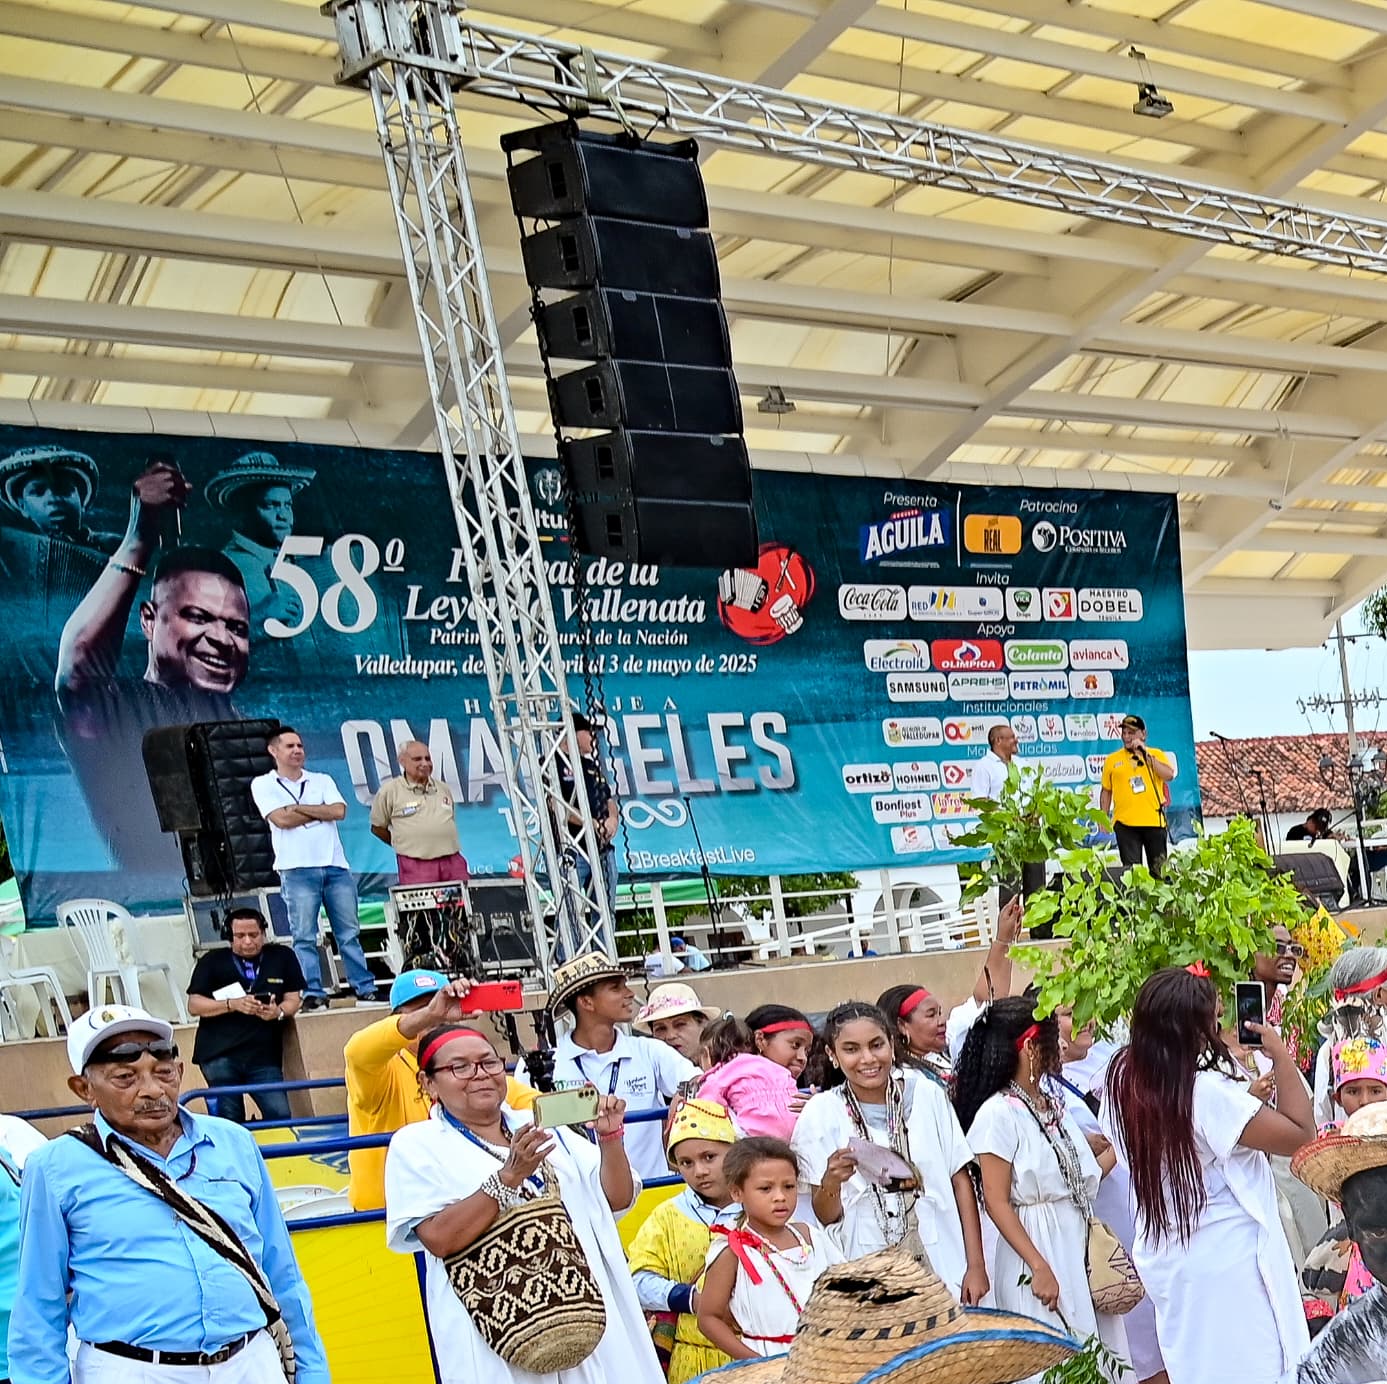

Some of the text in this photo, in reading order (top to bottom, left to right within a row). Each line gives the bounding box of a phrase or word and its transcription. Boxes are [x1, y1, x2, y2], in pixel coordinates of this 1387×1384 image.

[883, 491, 938, 508] Presenta
[1019, 499, 1078, 514] Patrocina
[864, 512, 945, 561] AGUILA
[983, 529, 1002, 553] REAL
[1059, 526, 1128, 549] POSITIVA
[586, 557, 624, 586] de
[976, 571, 1010, 586] Invita
[561, 586, 706, 623] Vallenata
[1081, 600, 1138, 613] DOBEL
[595, 629, 613, 646] de
[618, 629, 632, 646] la
[636, 628, 688, 646] Nación
[977, 622, 1015, 638] Apoya
[870, 656, 924, 669] Electrolit
[1007, 645, 1063, 663] Colanta
[1072, 648, 1112, 660] avianca
[355, 654, 458, 679] Valledupar,
[462, 654, 493, 674] de
[608, 653, 619, 674] 3
[623, 653, 644, 674] de
[647, 659, 691, 678] mayo
[695, 653, 714, 674] de
[718, 653, 758, 674] 2025
[889, 681, 946, 693] SAMSUNG
[962, 701, 1049, 713] Institucionales
